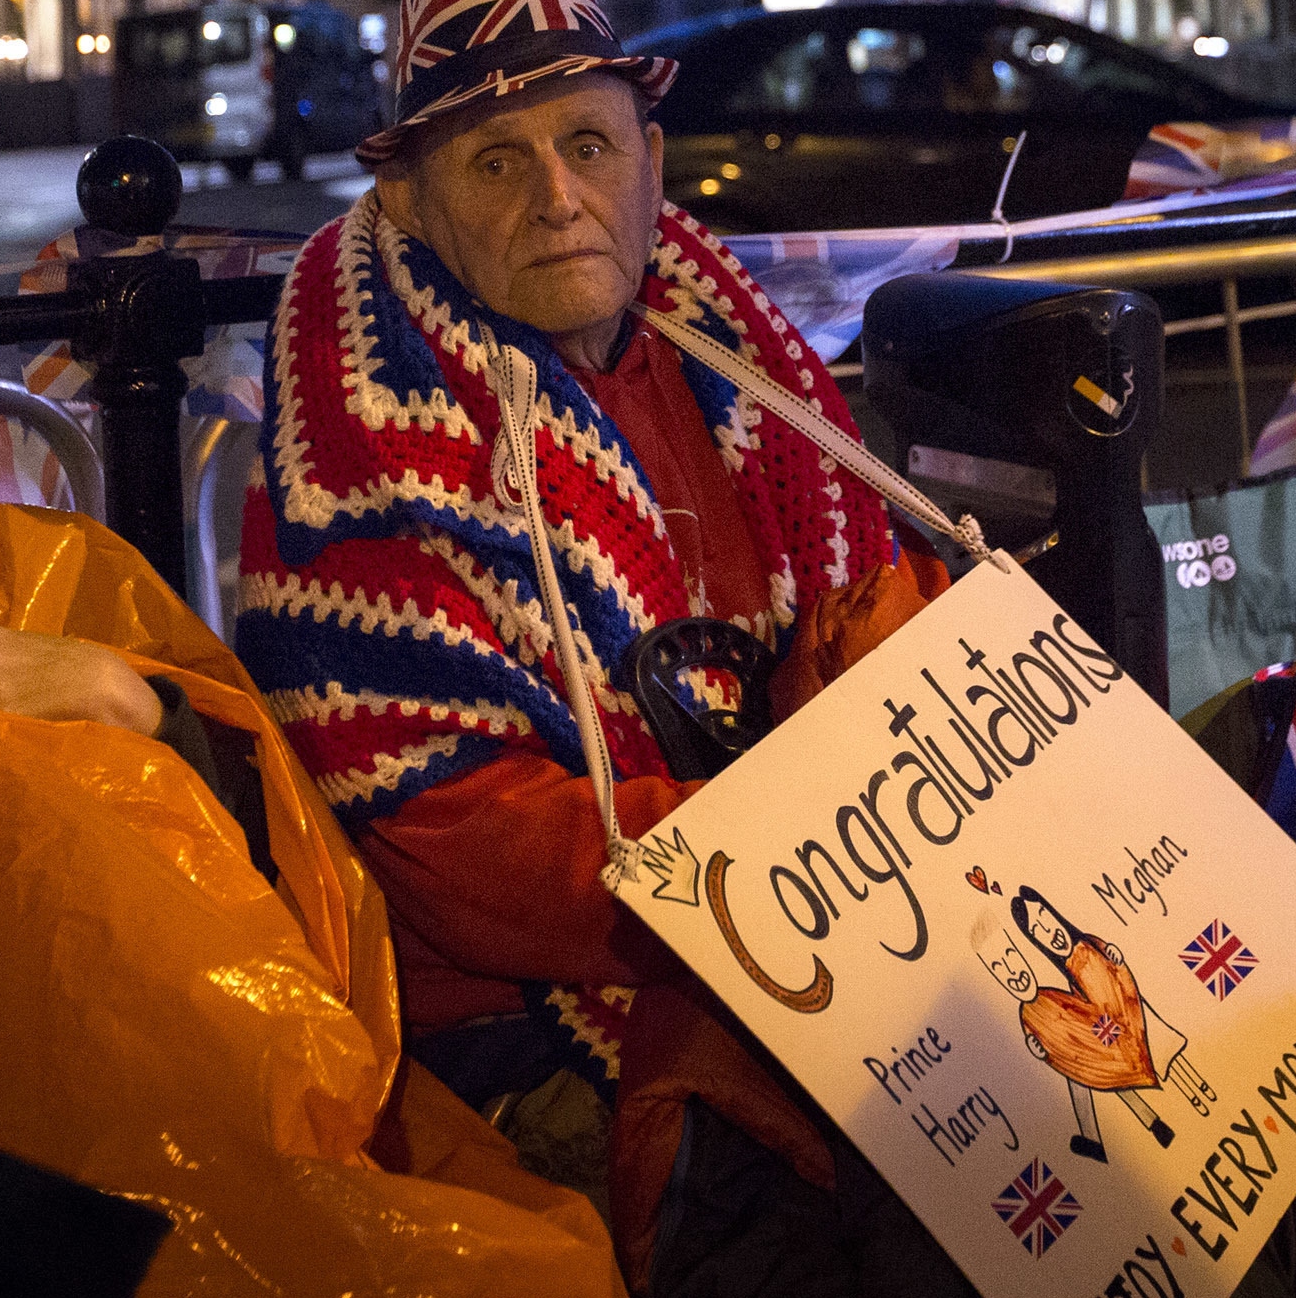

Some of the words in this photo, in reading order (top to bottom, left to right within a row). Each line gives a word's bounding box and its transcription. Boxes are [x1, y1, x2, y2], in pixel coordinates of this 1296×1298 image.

[705, 613, 1123, 1013] Congratulations
[1091, 834, 1189, 928] Meghan
[863, 1027, 951, 1104] Prince
[912, 1086, 1019, 1167] Harry
[1170, 1110, 1278, 1262] EVERY
